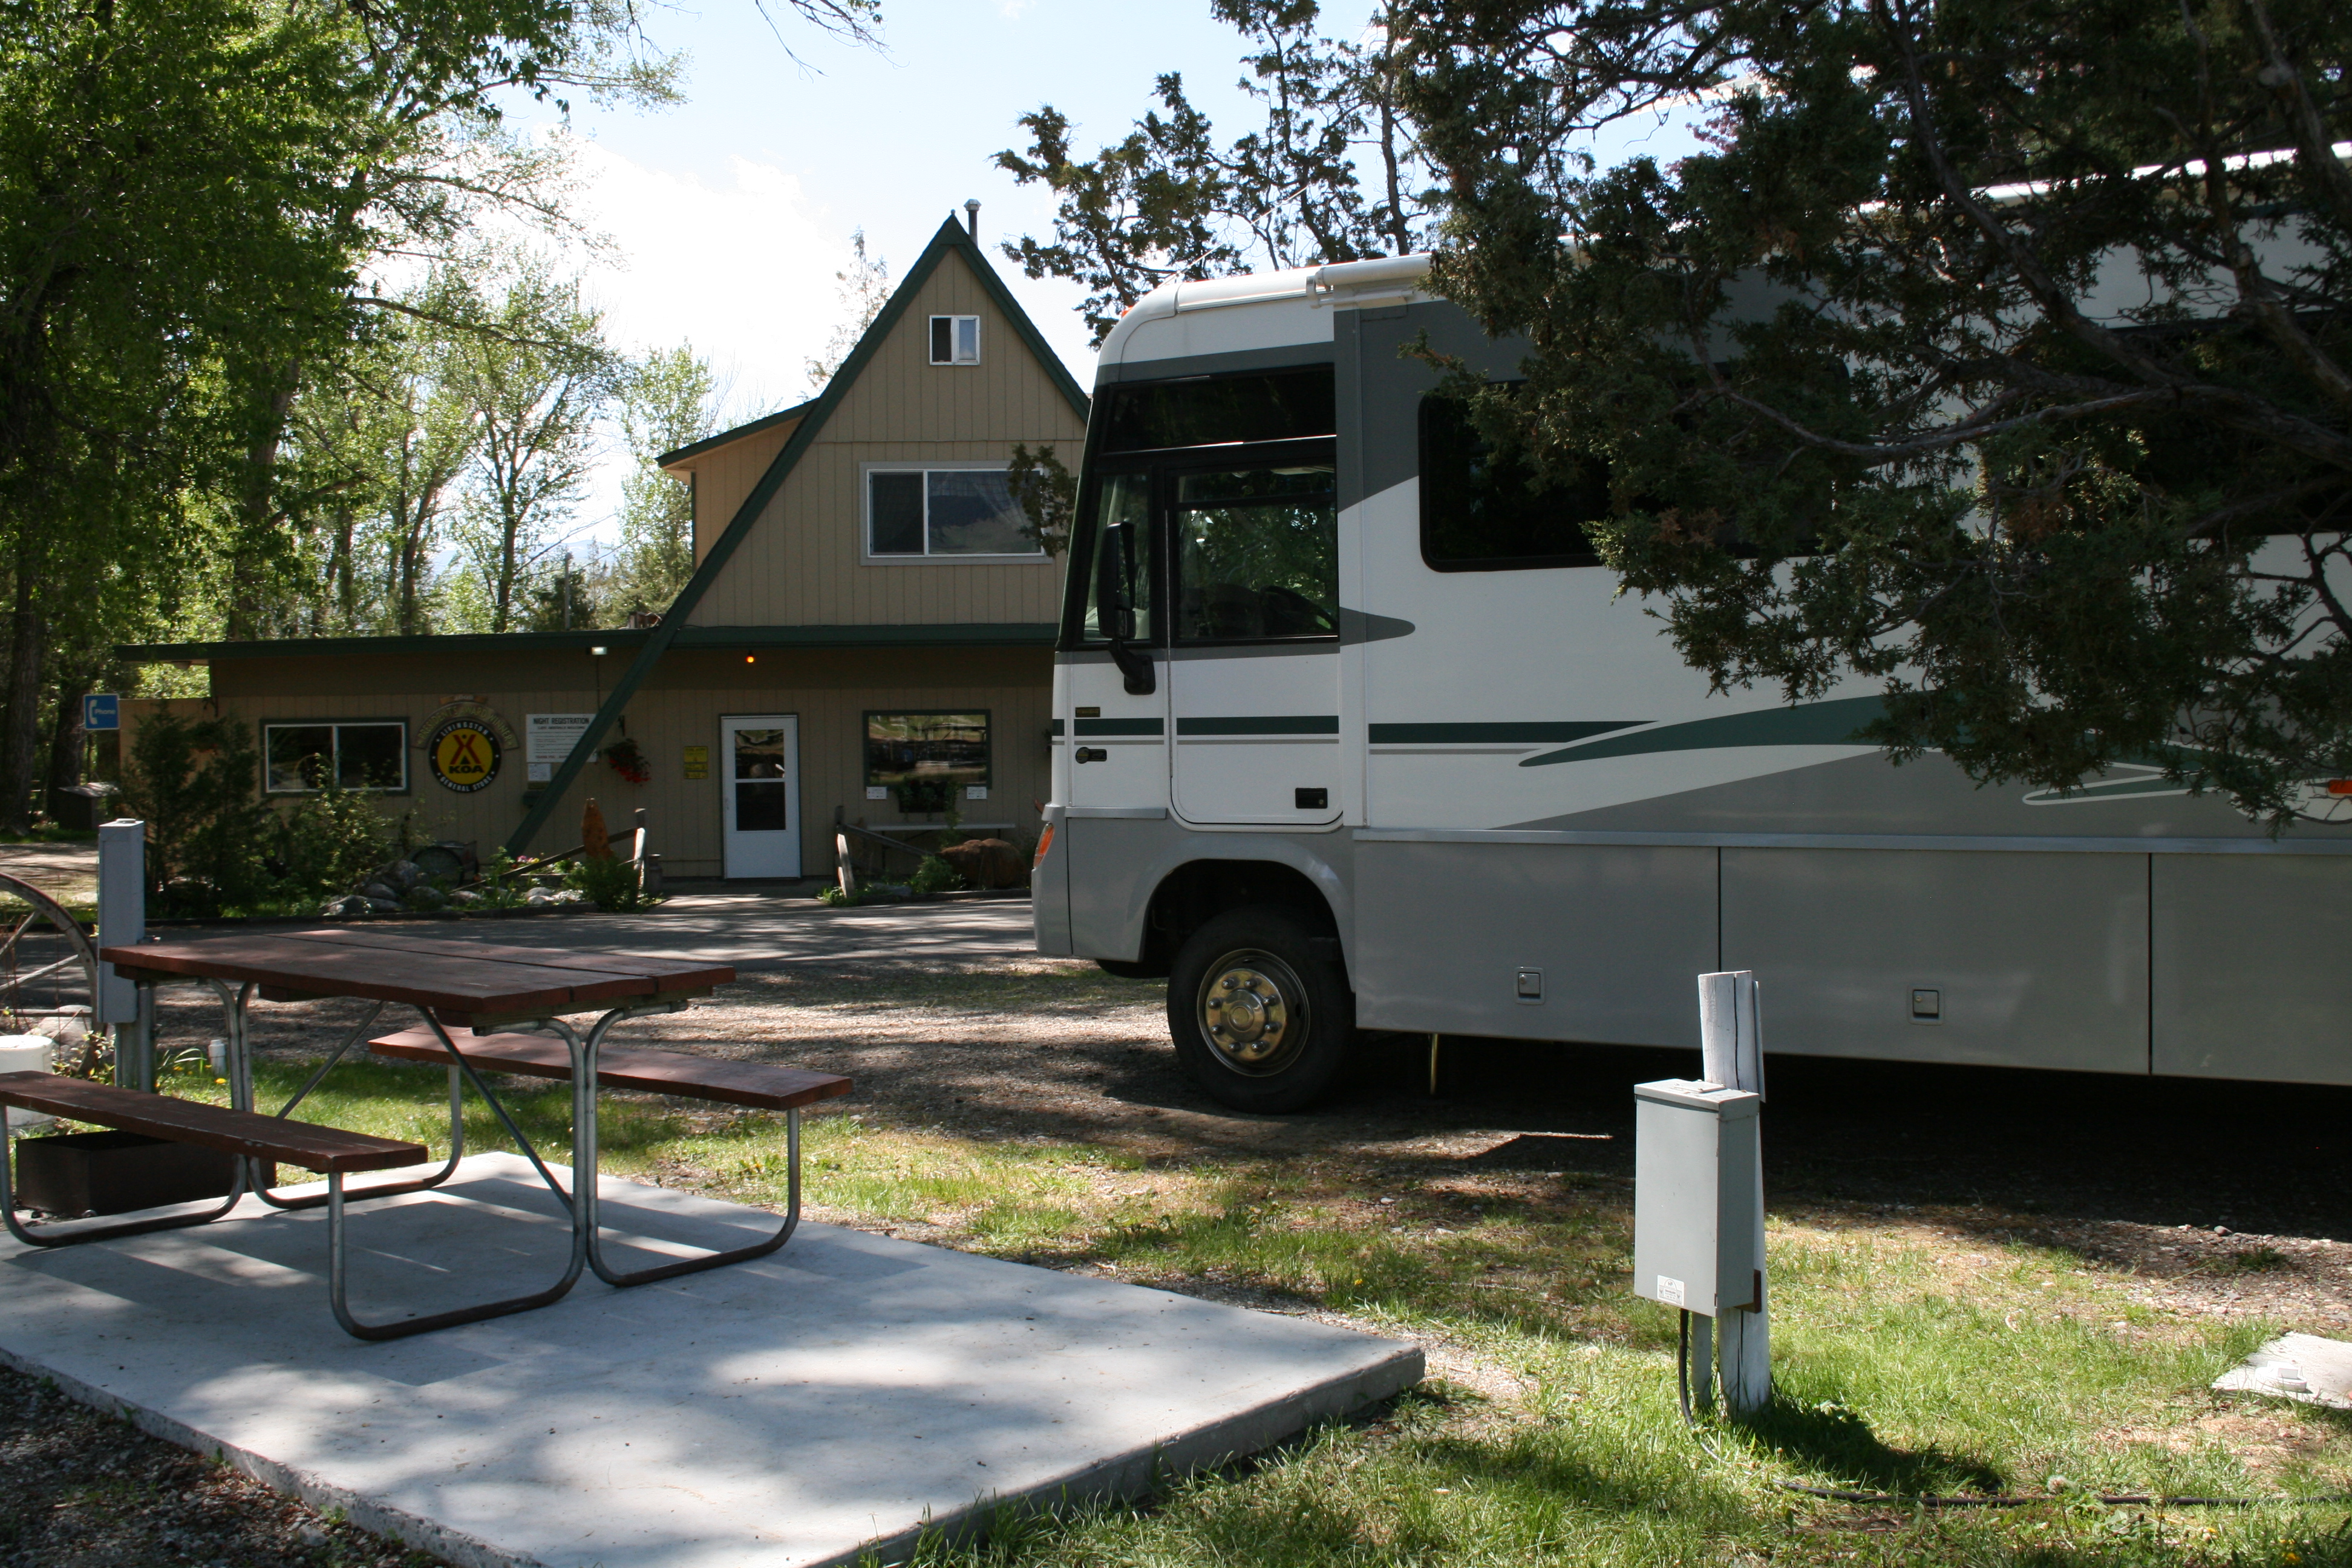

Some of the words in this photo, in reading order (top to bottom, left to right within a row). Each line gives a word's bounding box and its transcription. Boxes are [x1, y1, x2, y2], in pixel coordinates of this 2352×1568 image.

[440, 722, 489, 736] LIVINGSTON
[459, 706, 488, 718] AWARD
[488, 714, 512, 741] WINNER
[449, 765, 485, 774] KOA
[440, 776, 470, 792] GENERAL
[472, 776, 493, 790] STORE
